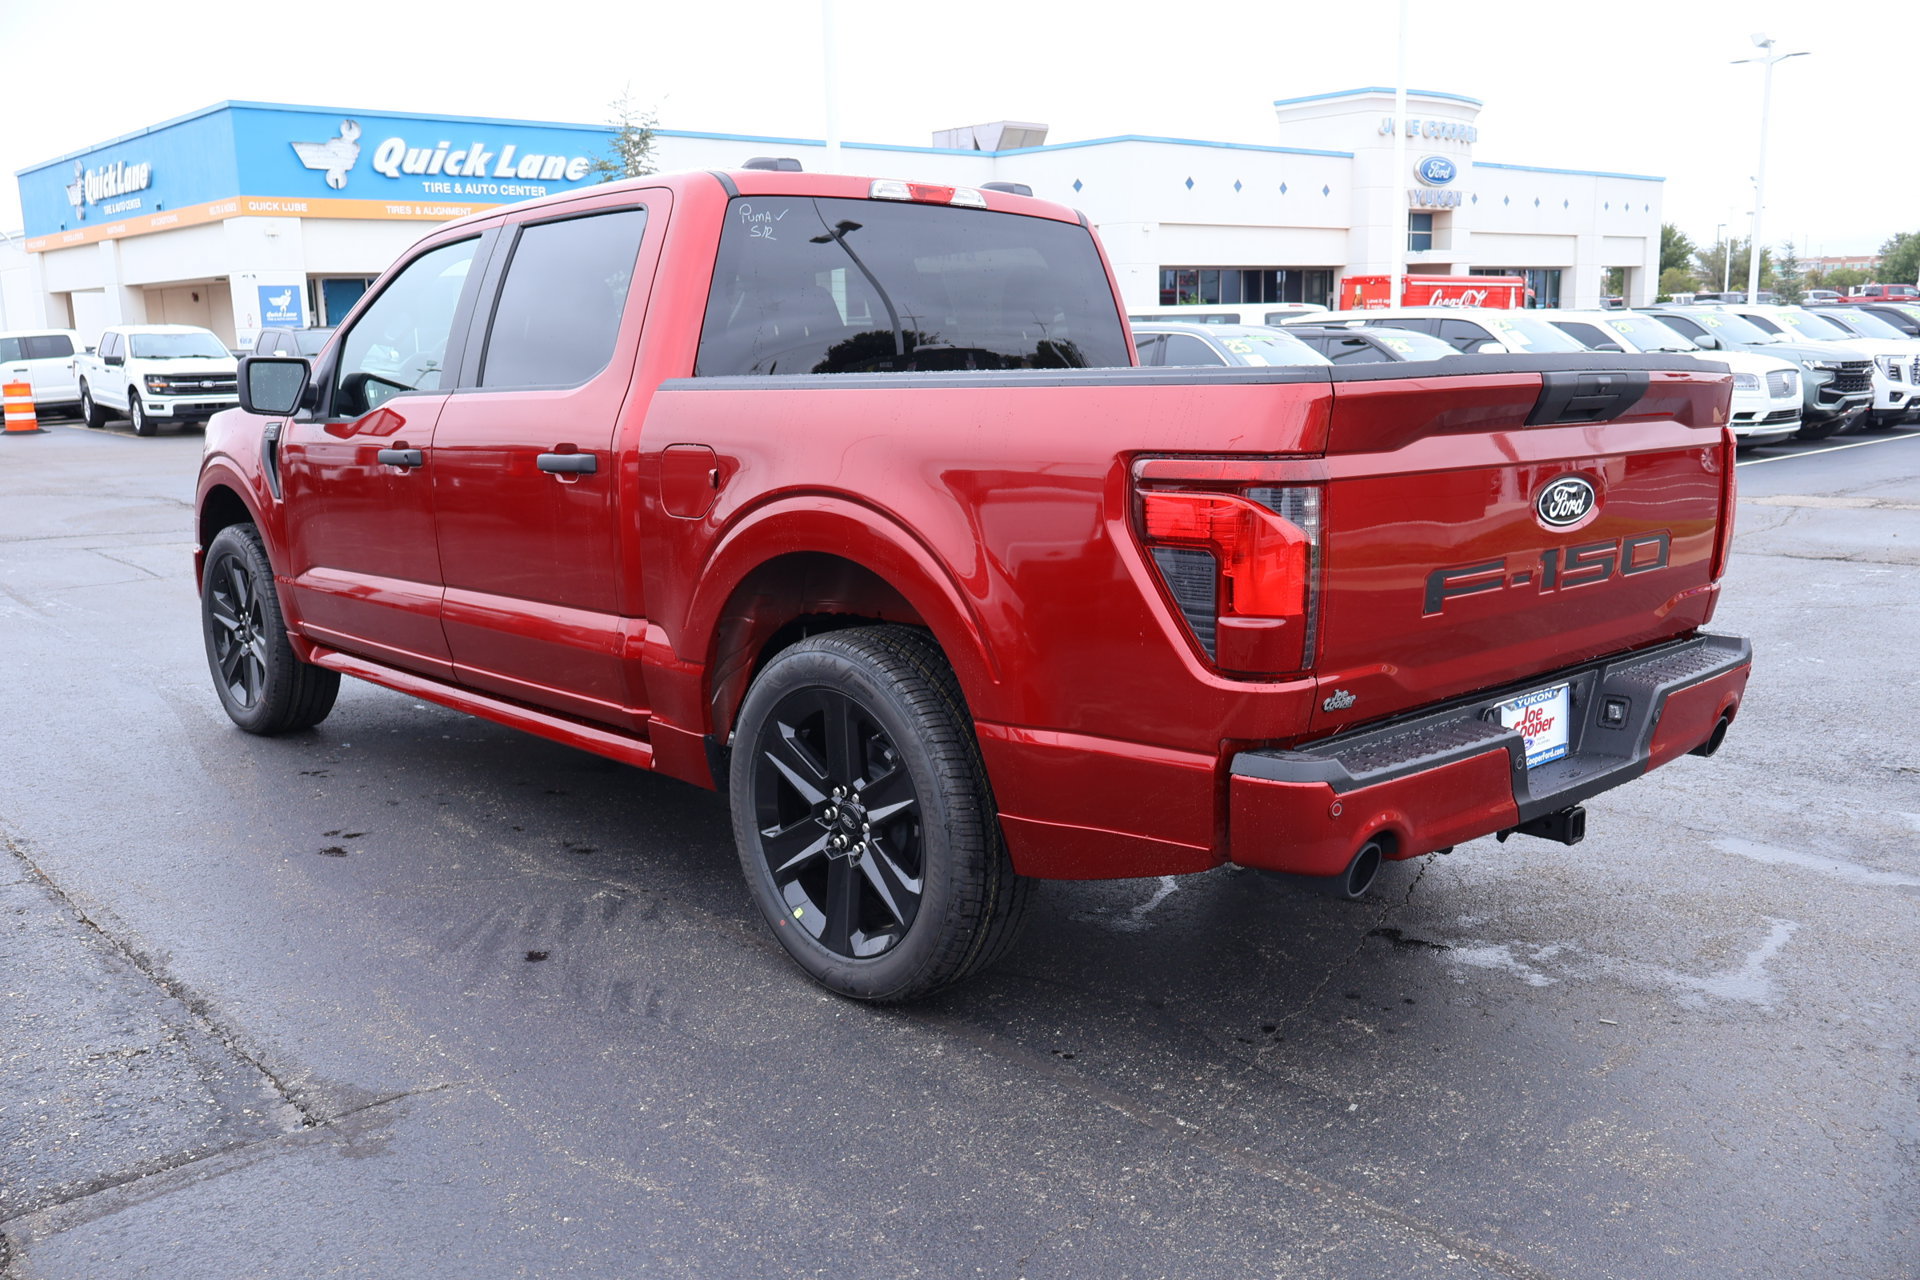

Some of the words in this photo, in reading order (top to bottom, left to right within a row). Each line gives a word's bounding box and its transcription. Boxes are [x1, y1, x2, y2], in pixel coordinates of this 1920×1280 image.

[372, 137, 496, 178] Quick
[492, 144, 590, 183] Lane
[1427, 160, 1451, 179] Ford
[84, 163, 118, 206] Quick
[116, 160, 151, 195] Lane
[422, 181, 452, 194] TIRE
[453, 184, 463, 194] &
[464, 184, 498, 196] AUTO
[500, 185, 547, 197] CENTER
[248, 201, 279, 212] QUICK
[281, 202, 308, 213] LUBE
[386, 205, 412, 215] TIRES
[415, 206, 422, 215] &
[423, 206, 472, 217] ALIGNMENT
[1550, 485, 1586, 518] Ford
[1422, 530, 1672, 617] F-150
[1323, 694, 1356, 712] Cooper
[1333, 689, 1349, 702] Joe
[1517, 690, 1553, 708] YUKON
[1521, 705, 1544, 726] Joe
